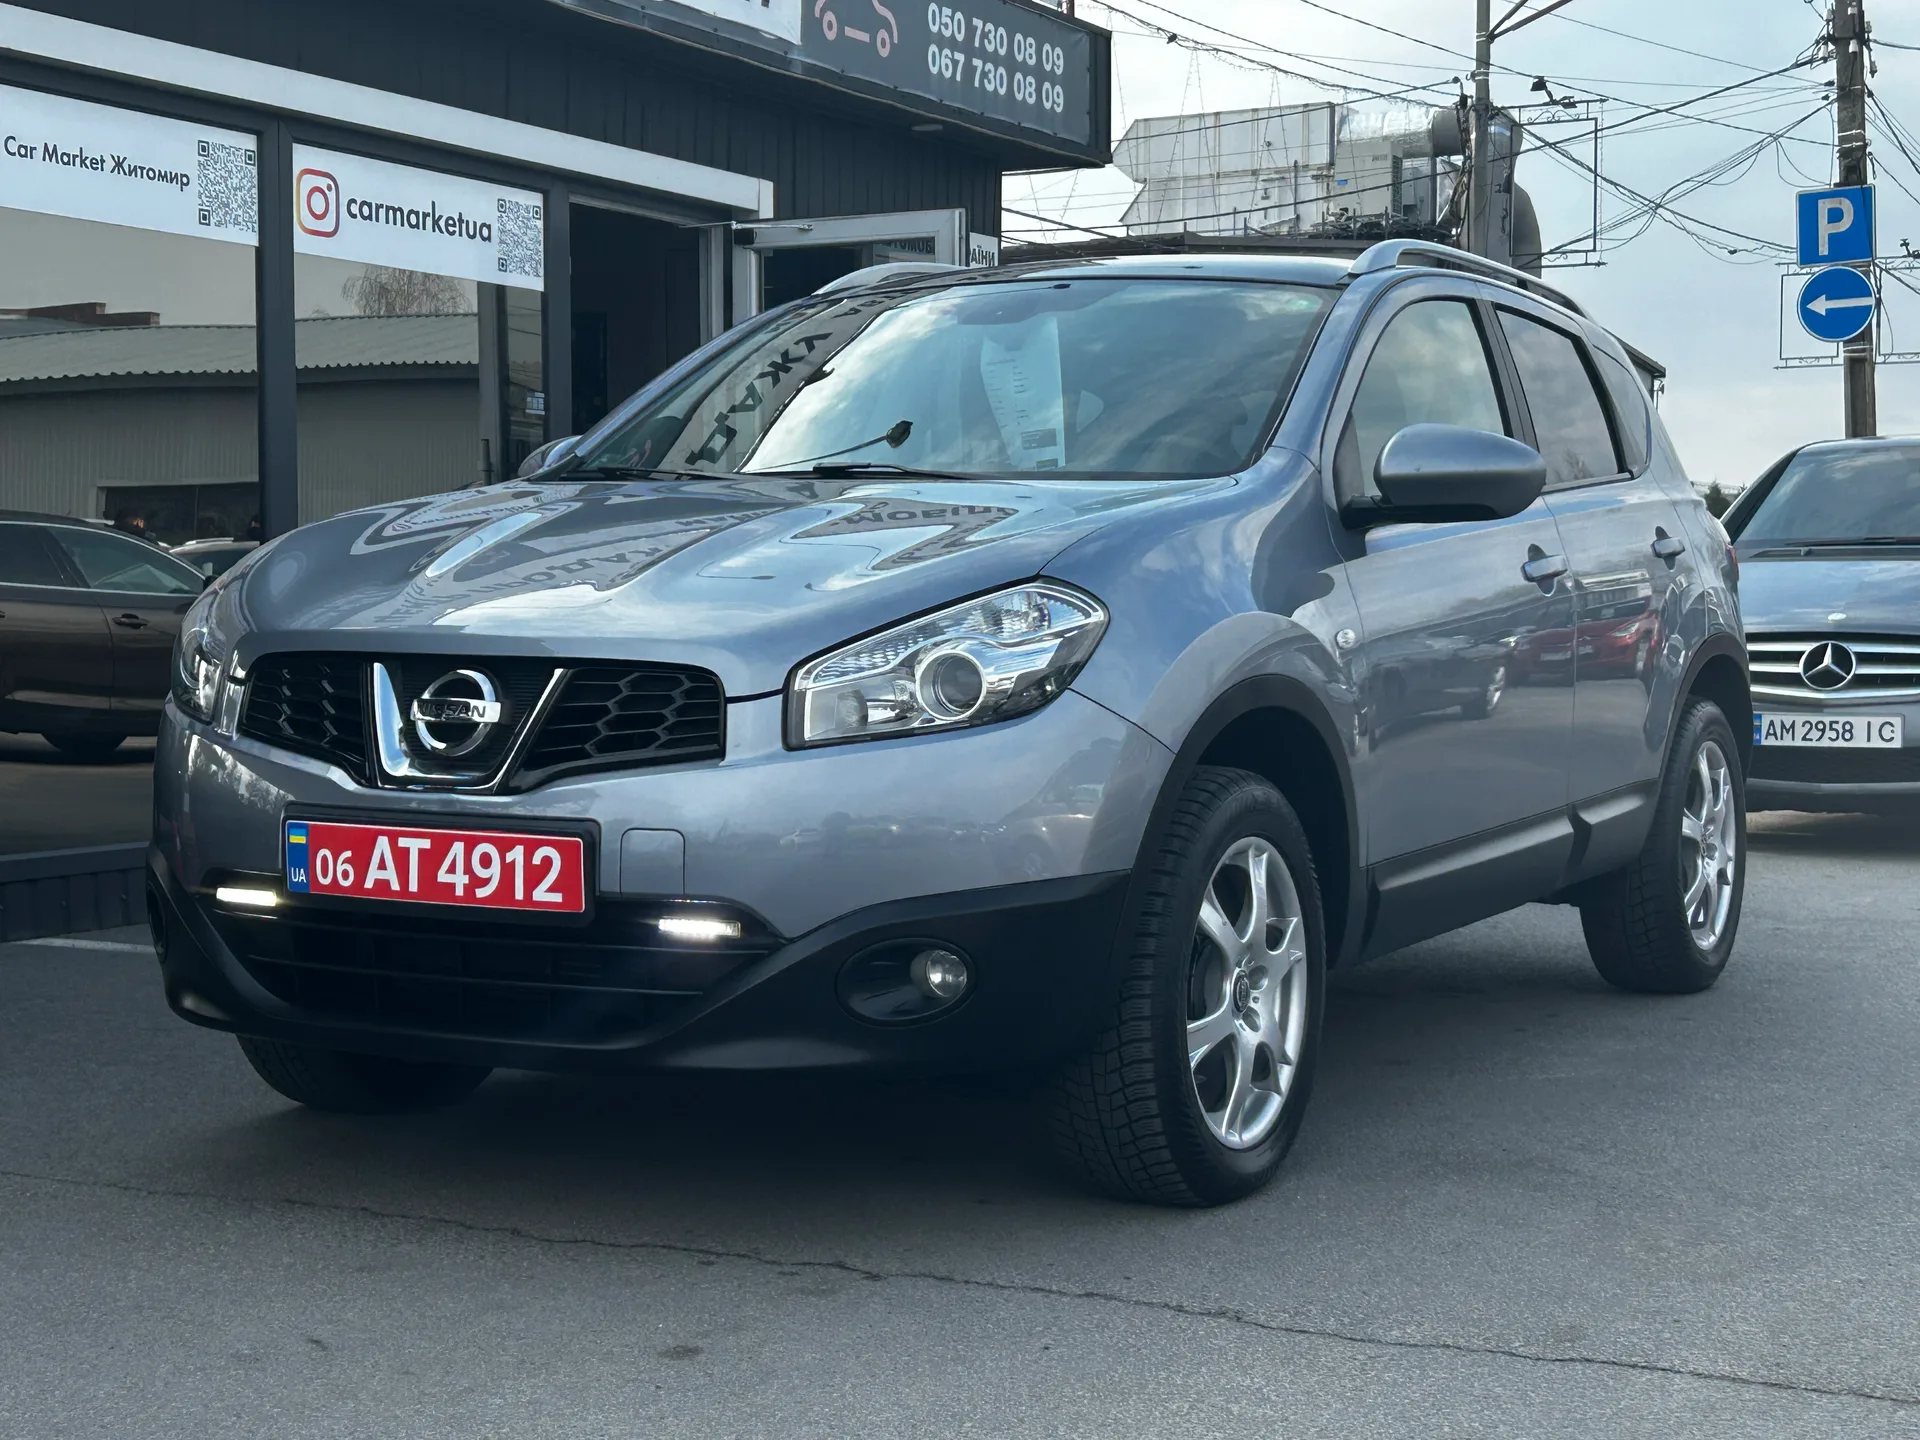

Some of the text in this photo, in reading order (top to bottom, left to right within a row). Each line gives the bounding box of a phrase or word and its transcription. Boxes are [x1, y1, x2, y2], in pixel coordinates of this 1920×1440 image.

[927, 2, 1064, 75] 050 730 08 09
[927, 43, 1064, 113] 067 730 08 09
[3, 135, 191, 192] Car Market Житомир
[346, 197, 492, 243] carmarketua
[1817, 197, 1854, 256] P
[969, 244, 996, 267] АЇНИ
[1764, 719, 1796, 742] AM
[1801, 720, 1854, 742] 2958
[291, 867, 307, 884] UA
[315, 835, 563, 903] 06 AT 4912
